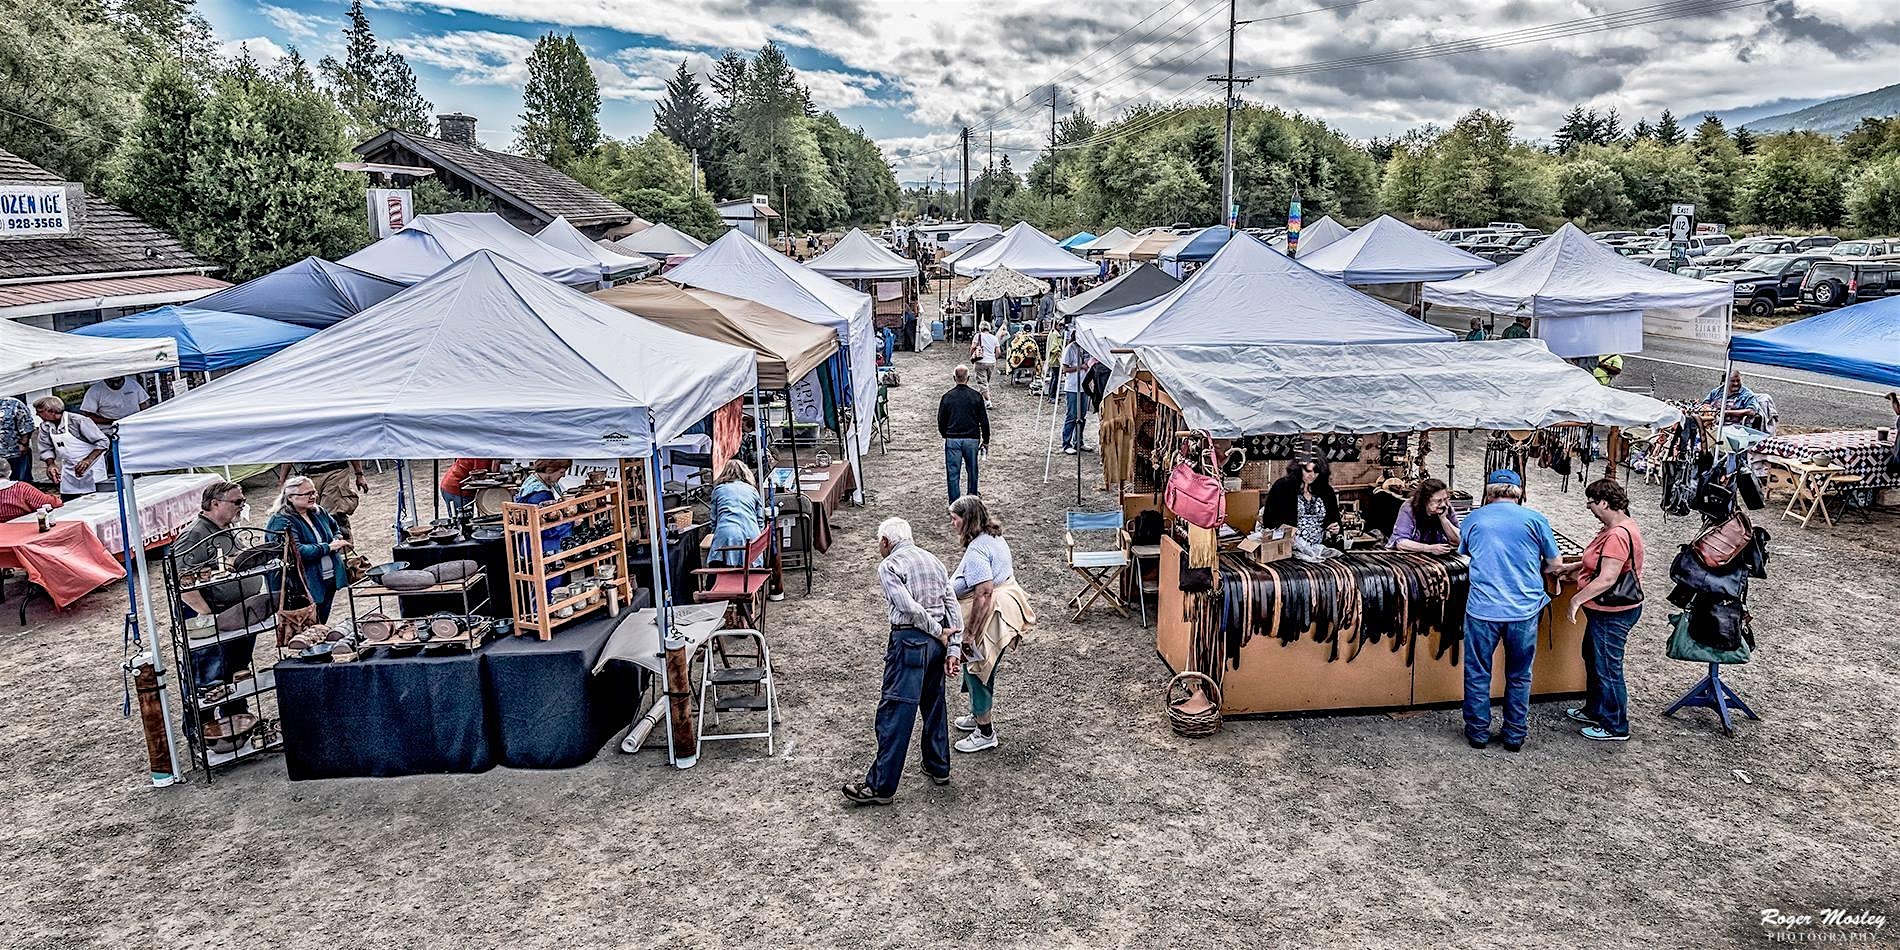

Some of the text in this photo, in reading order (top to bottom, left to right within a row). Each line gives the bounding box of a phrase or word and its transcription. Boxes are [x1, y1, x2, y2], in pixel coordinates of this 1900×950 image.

[0, 194, 61, 214] OZEN ICE
[8, 218, 63, 229] 928-3568
[1675, 221, 1686, 230] 112
